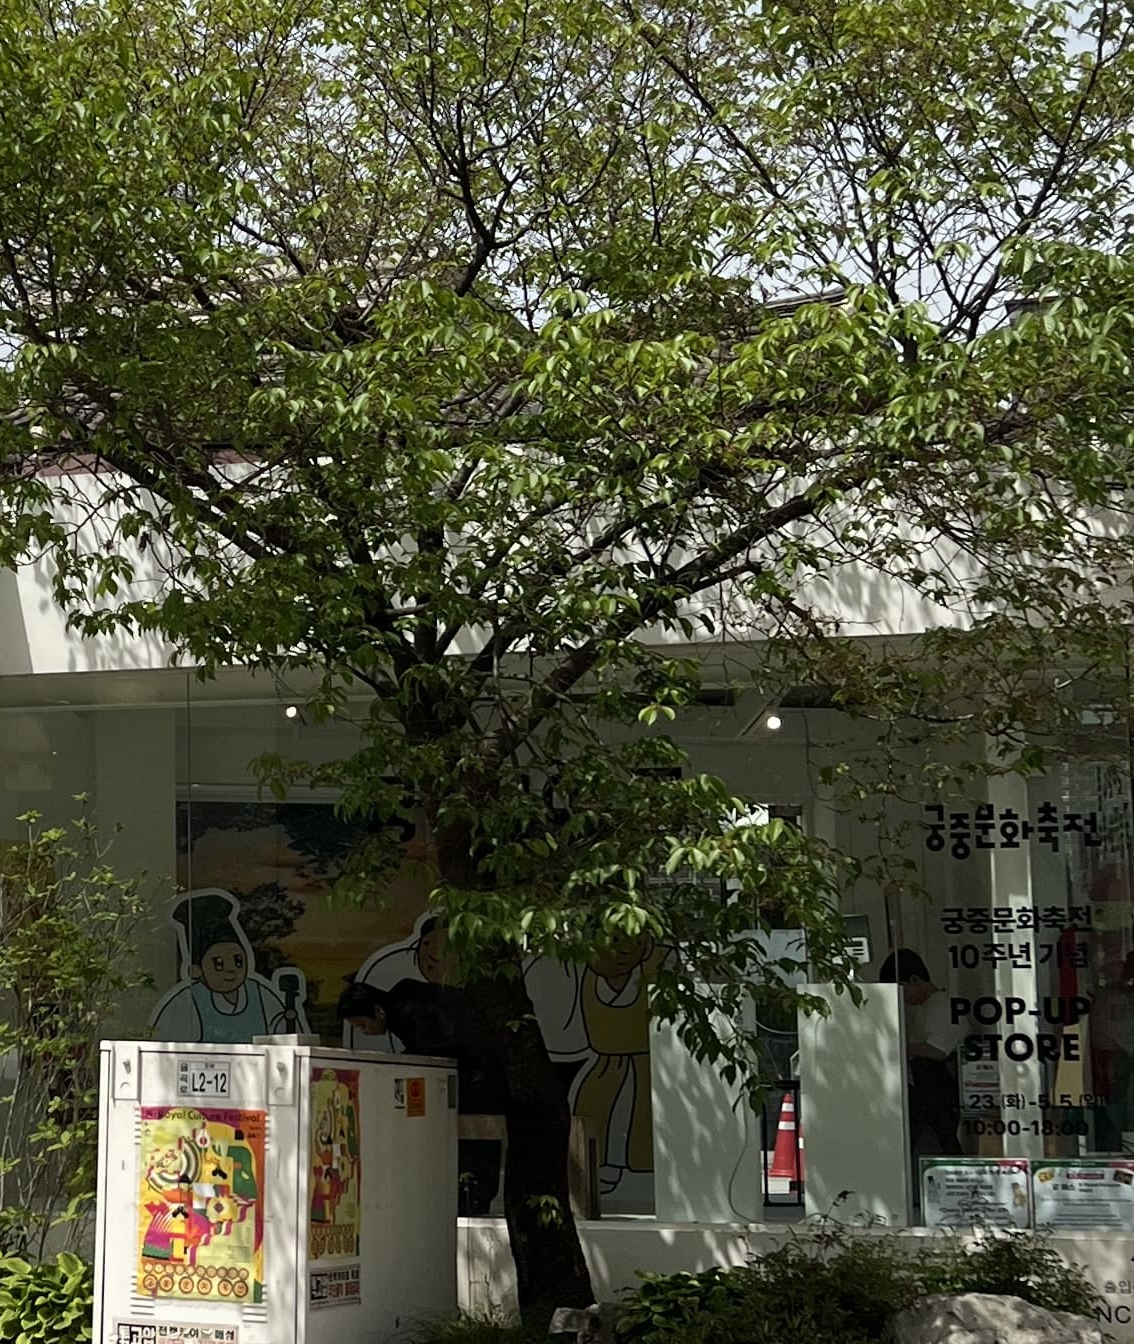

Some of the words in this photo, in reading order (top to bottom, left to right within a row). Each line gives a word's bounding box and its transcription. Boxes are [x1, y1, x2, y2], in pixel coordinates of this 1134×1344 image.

[924, 802, 1102, 860] 궁중문화축전
[941, 906, 1092, 934] 궁중문화축전
[948, 942, 1032, 969] 10주년
[950, 997, 1091, 1025] POP-UP
[964, 1033, 1080, 1062] STORE
[192, 1072, 227, 1093] L2-12
